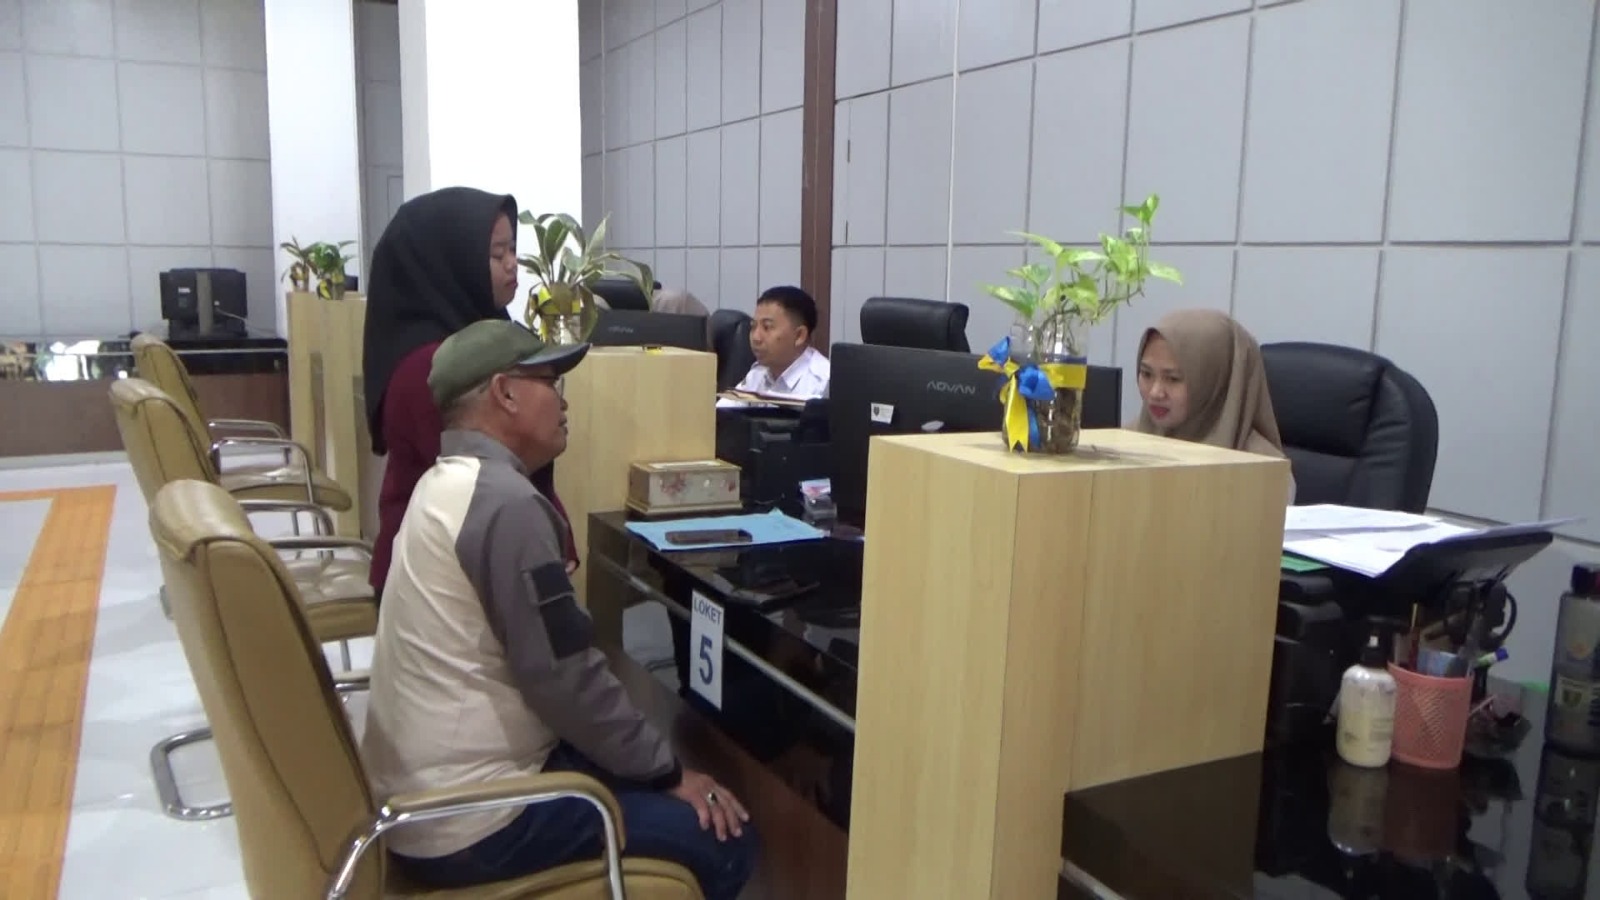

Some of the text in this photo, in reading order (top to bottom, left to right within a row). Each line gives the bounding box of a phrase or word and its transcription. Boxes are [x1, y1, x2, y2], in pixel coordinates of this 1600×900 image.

[927, 381, 976, 395] ADVAN
[694, 598, 722, 624] LOKET
[699, 634, 714, 686] 5
